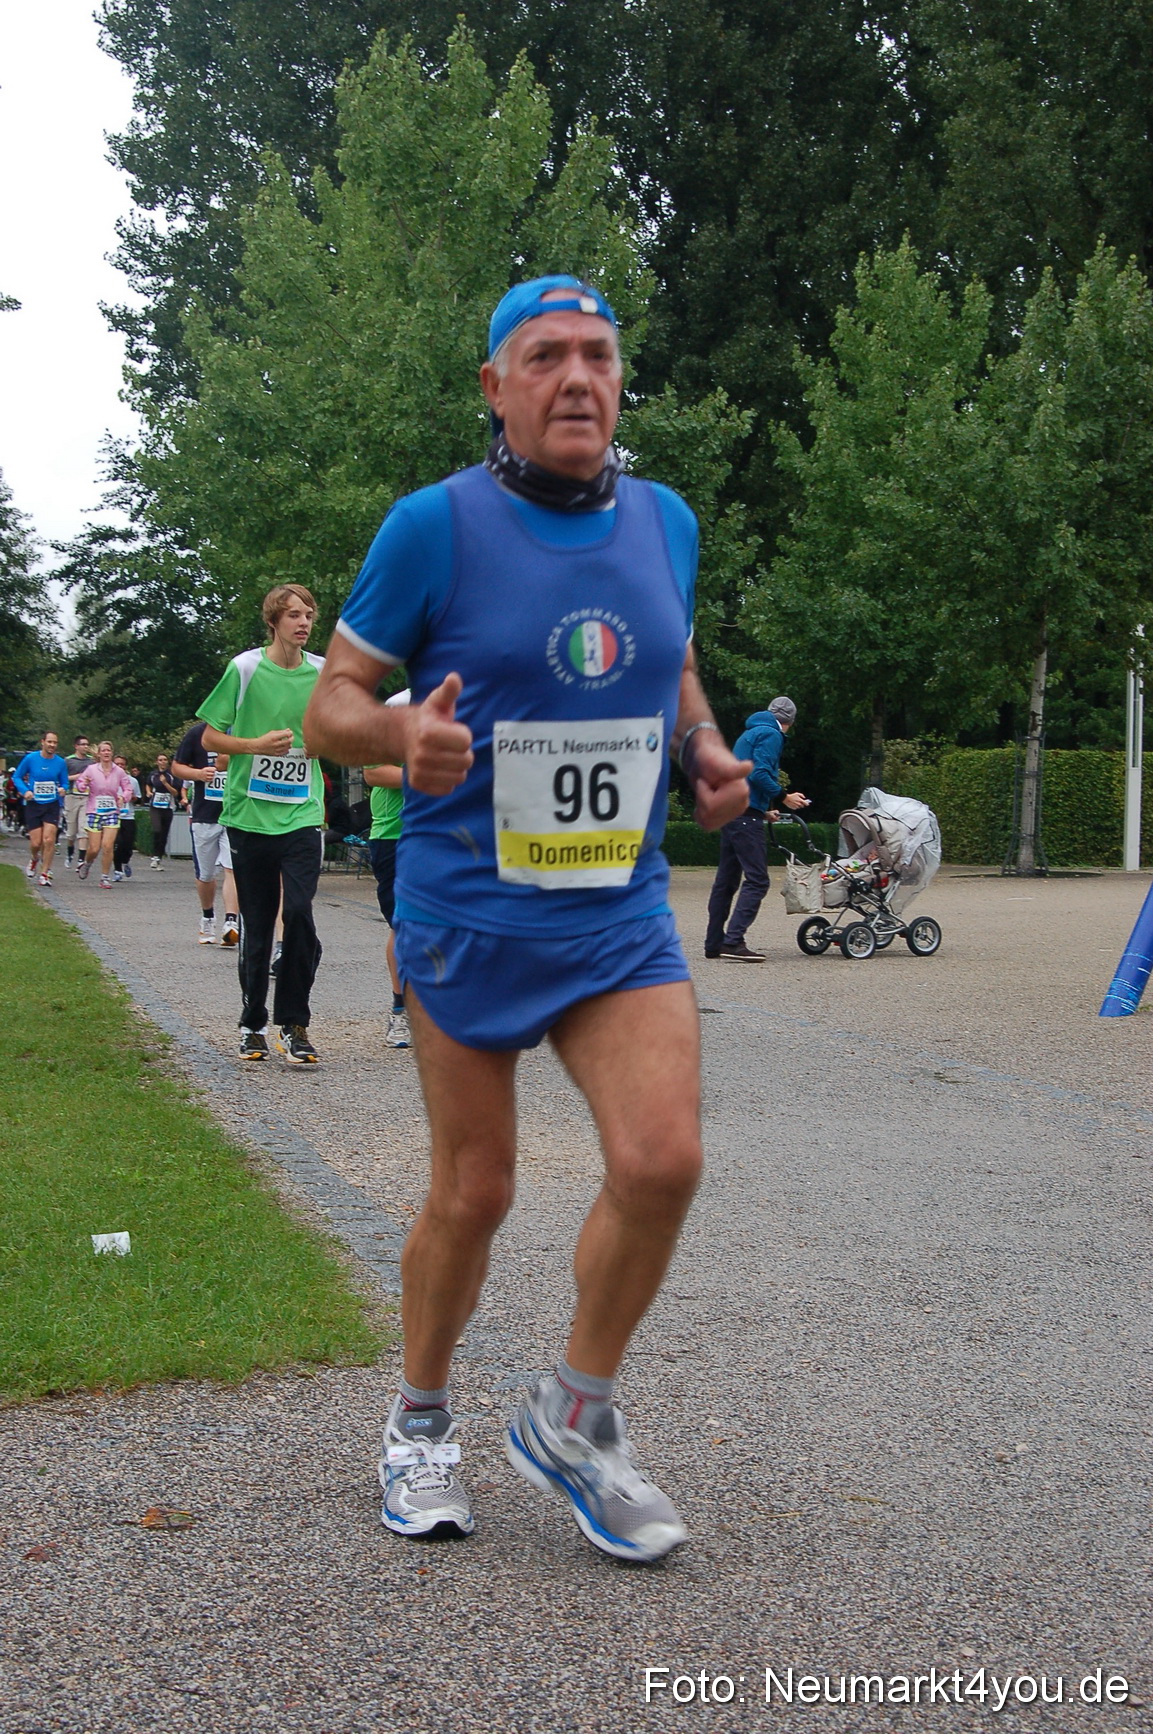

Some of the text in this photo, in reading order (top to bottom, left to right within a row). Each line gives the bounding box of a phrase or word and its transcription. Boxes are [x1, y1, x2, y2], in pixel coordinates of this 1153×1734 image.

[498, 737, 640, 755] PARTL Neumarkt
[257, 757, 307, 783] 2829
[264, 783, 295, 796] Samuel
[553, 762, 619, 824] 96
[528, 838, 641, 866] Domenico
